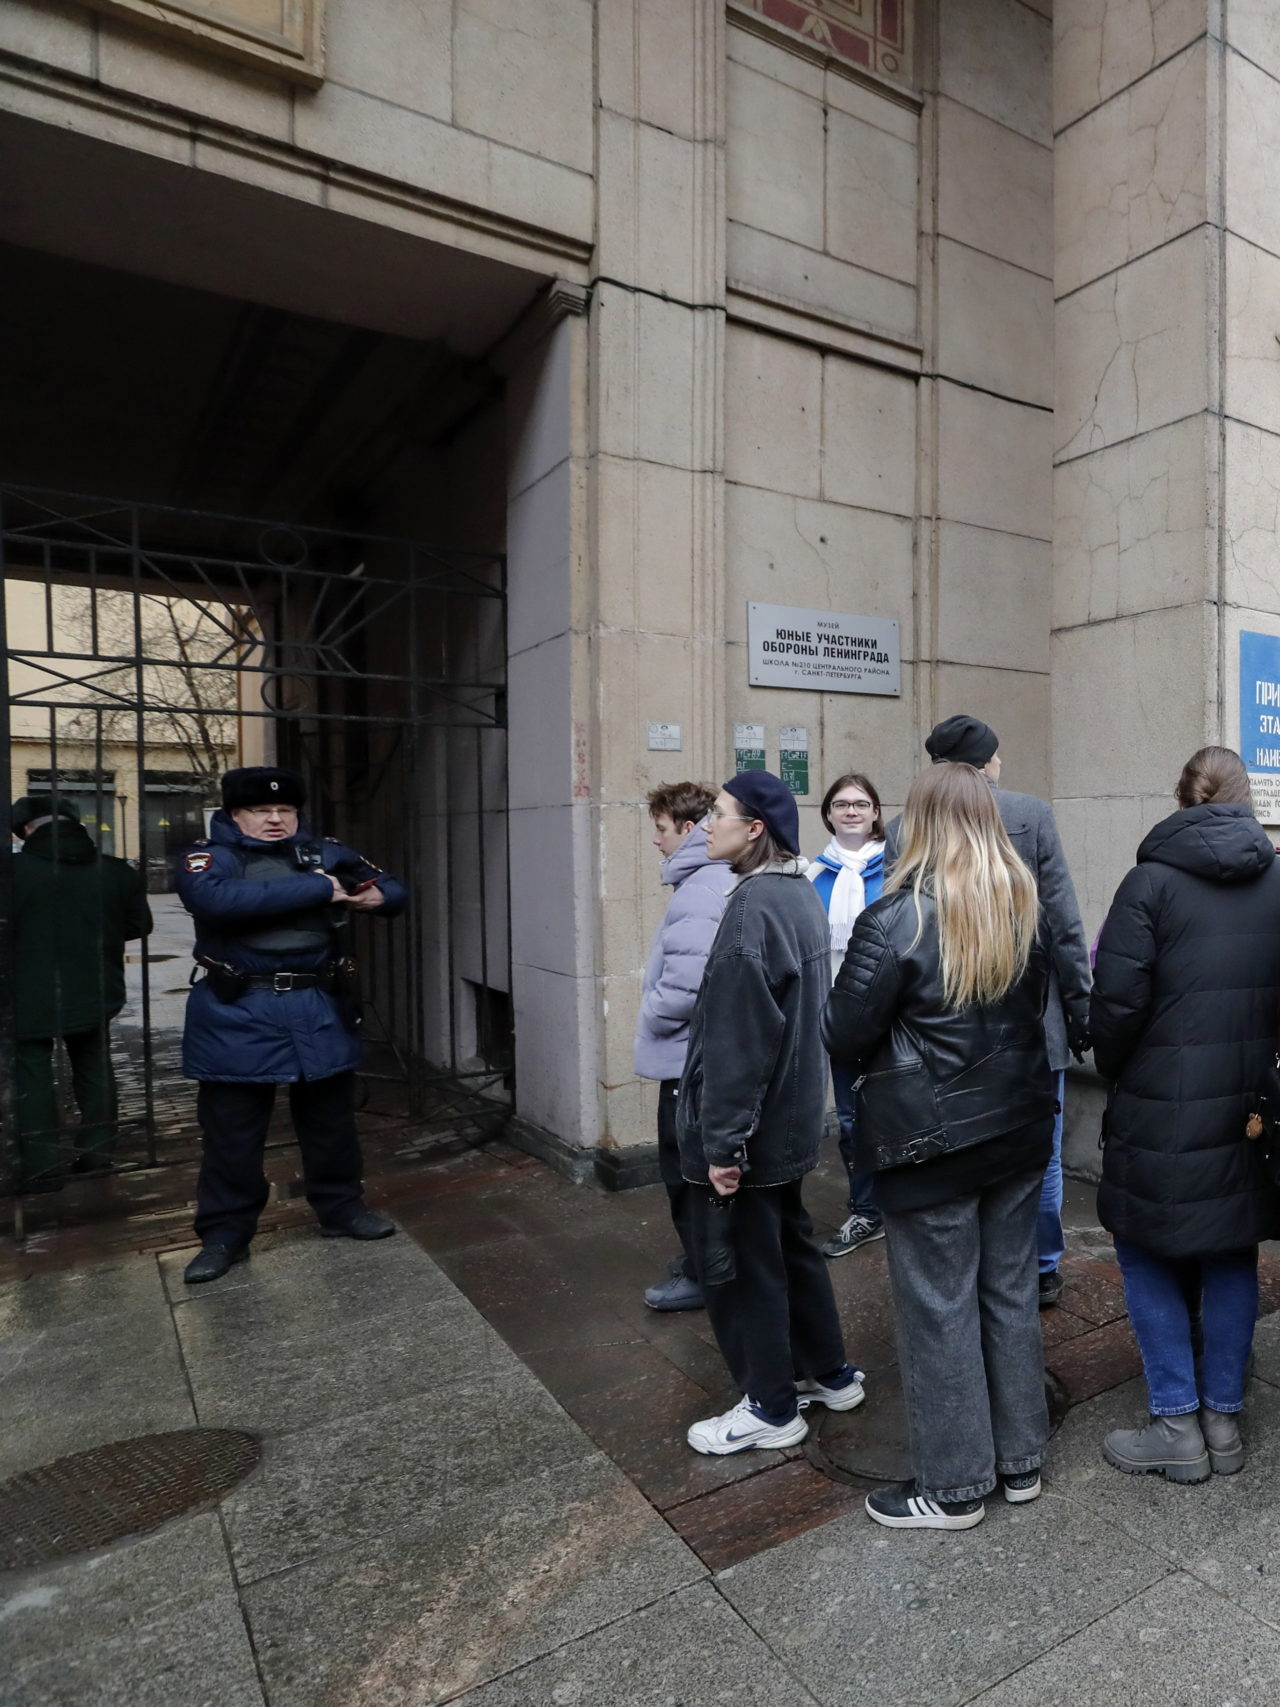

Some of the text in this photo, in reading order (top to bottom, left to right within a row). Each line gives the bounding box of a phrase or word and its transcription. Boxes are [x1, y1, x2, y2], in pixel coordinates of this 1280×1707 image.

[817, 621, 839, 629] МУЗЕЙ
[776, 628, 877, 649] ЮНЫЕ УЧАСТНИКИ
[762, 640, 890, 664] ОБОРОНЫ ЛЕНИНГРАДА
[763, 658, 890, 676] ШКОЛА №210 ЦЕНТРАЛЬНОГО РАЙОНА
[802, 669, 862, 680] САНКТ-ПЕТЕРБУРГА
[1255, 680, 1280, 707] ПРИ
[1259, 715, 1280, 736] ЭТА
